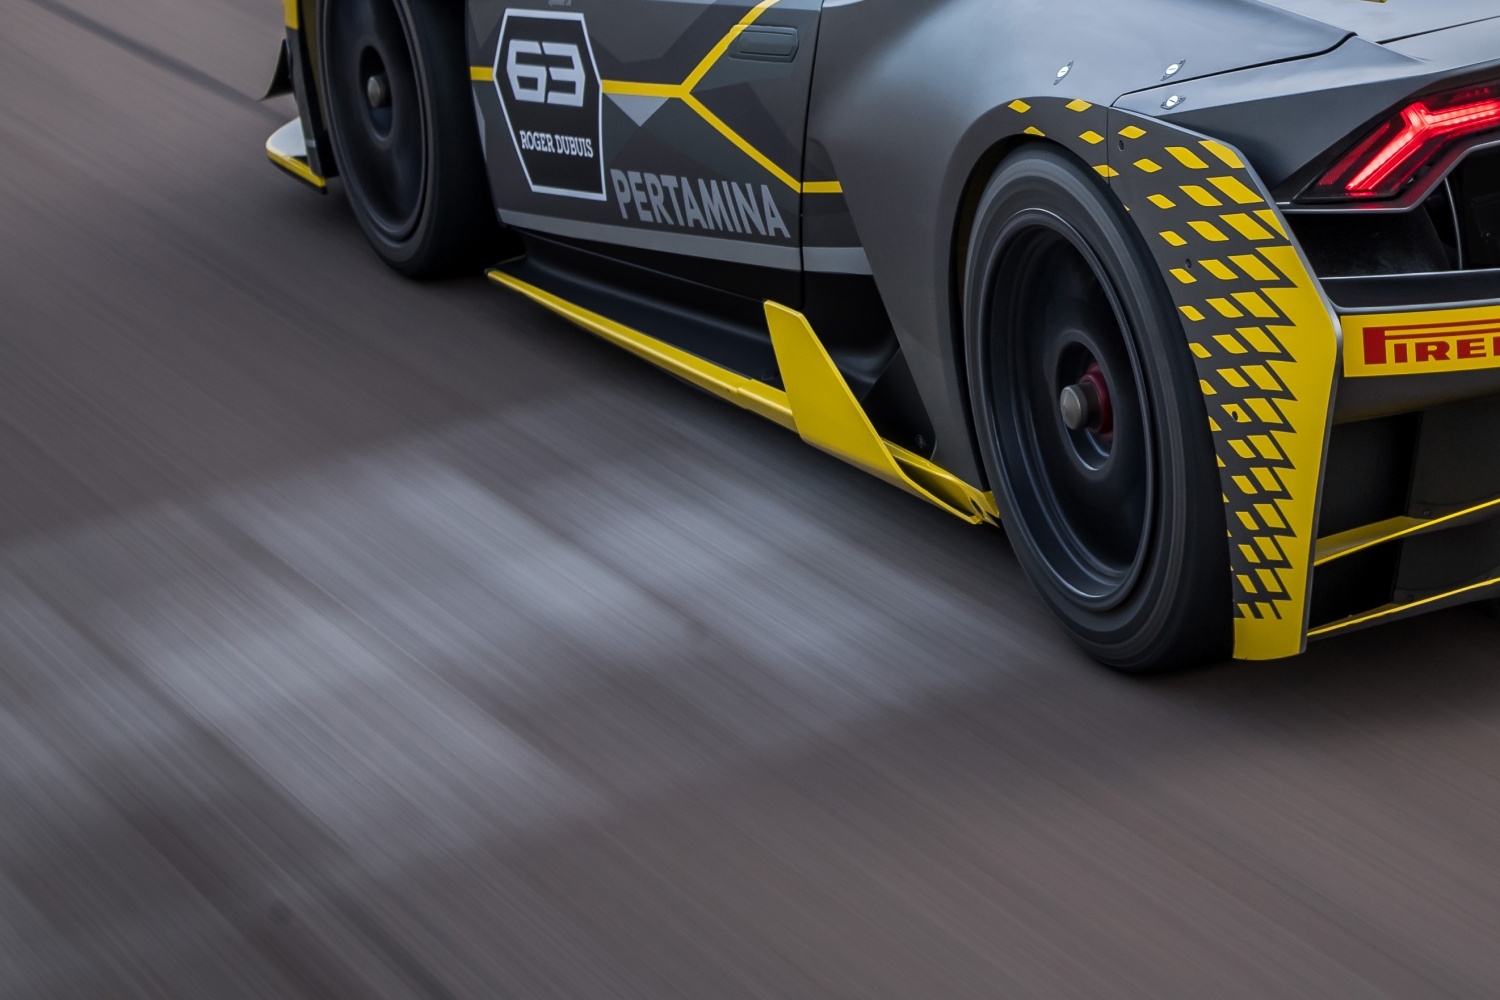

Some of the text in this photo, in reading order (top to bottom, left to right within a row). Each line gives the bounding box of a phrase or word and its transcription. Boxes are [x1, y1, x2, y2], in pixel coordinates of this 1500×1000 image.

[506, 39, 585, 107] 63
[519, 130, 594, 158] ROGER DUBUIS
[610, 168, 791, 239] PERTAMINA
